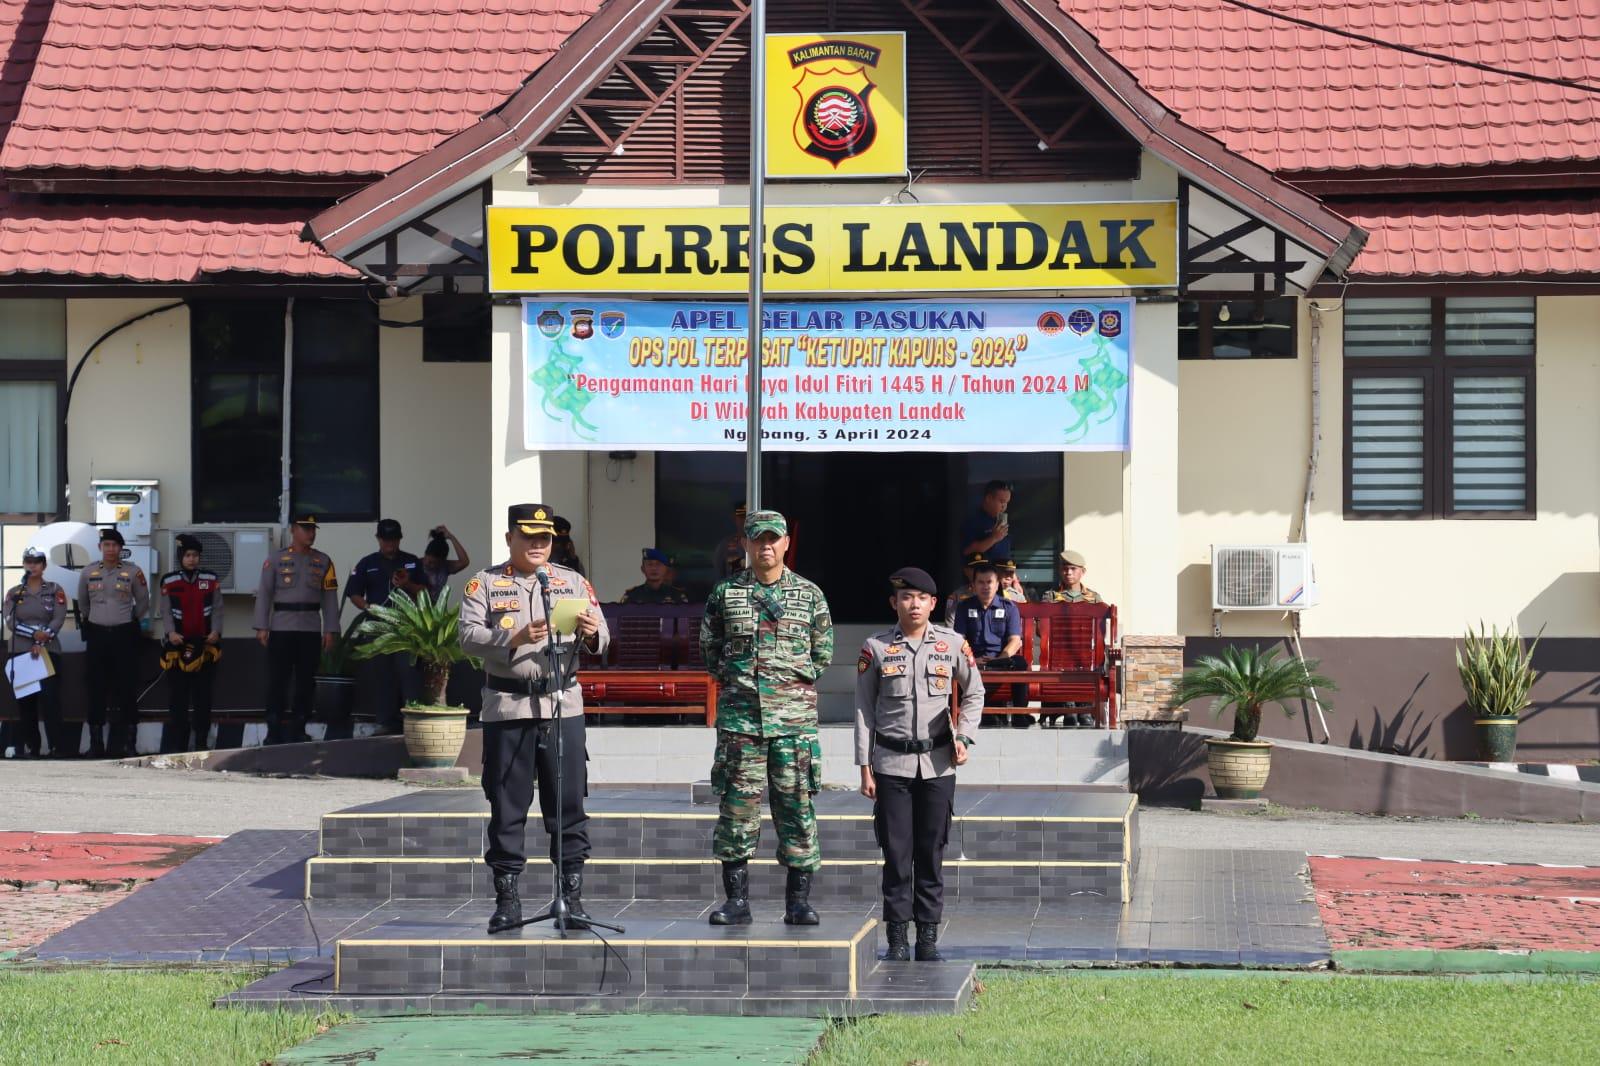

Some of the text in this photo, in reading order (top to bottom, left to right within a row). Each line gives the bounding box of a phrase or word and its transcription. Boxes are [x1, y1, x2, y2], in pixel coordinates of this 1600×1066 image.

[793, 45, 876, 62] KALIMANTAN BARAT
[510, 219, 1156, 275] POLRES LANDAK
[671, 310, 742, 330] APEL
[854, 310, 986, 330] PASUKAN
[629, 336, 664, 367] OPS
[666, 336, 699, 367] POL
[703, 336, 794, 367] TERPSAT
[888, 336, 957, 367] KAPUAS
[701, 374, 738, 393] Hari
[795, 374, 829, 393] Idul
[836, 375, 873, 393] Fitri
[880, 375, 925, 393] 1445
[932, 375, 943, 393] H
[962, 375, 1015, 393] Tahun
[1022, 375, 1068, 393] 2024
[1074, 374, 1089, 392] M
[690, 402, 708, 420] Di
[795, 402, 892, 424] Kabupaten
[899, 402, 966, 421] Landak
[724, 429, 932, 442] Ngbang, 3 April 2024
[928, 654, 952, 662] POLRI
